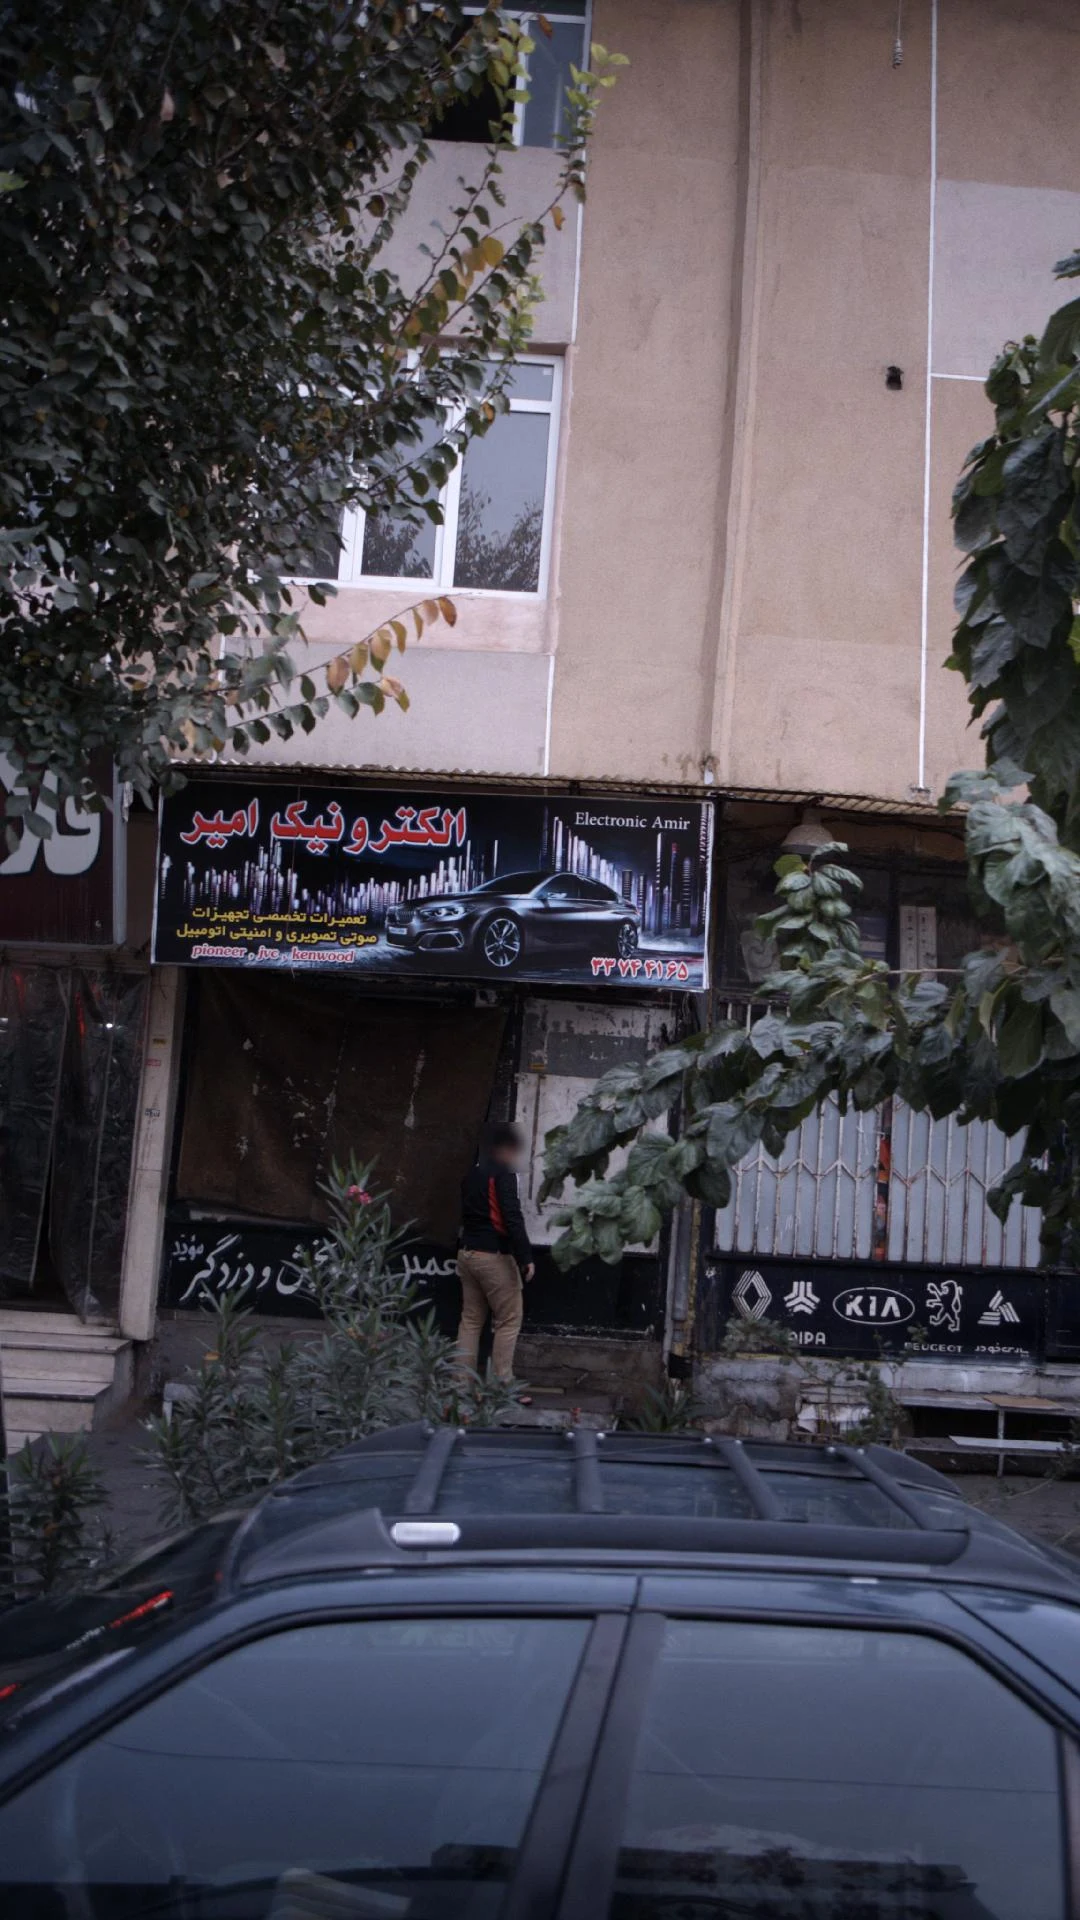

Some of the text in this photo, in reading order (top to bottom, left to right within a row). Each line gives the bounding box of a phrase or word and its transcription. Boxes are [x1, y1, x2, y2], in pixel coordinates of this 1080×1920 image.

[180, 798, 466, 854] الکترونیک امیر
[575, 812, 690, 830] Electronic Amir
[192, 907, 367, 925] تعمیرات تخصصی تجهیزات
[176, 923, 377, 946] صوتی تصویری و امنیتی اتومبیل
[191, 943, 247, 959] pioneer
[257, 945, 280, 961] jvc
[291, 946, 355, 962] kenwood
[179, 1233, 255, 1301] دزدگیر
[257, 1266, 271, 1289] و
[846, 1295, 901, 1318] KIA
[786, 1330, 827, 1346] AIPA
[904, 1342, 963, 1354] PEUGEOT
